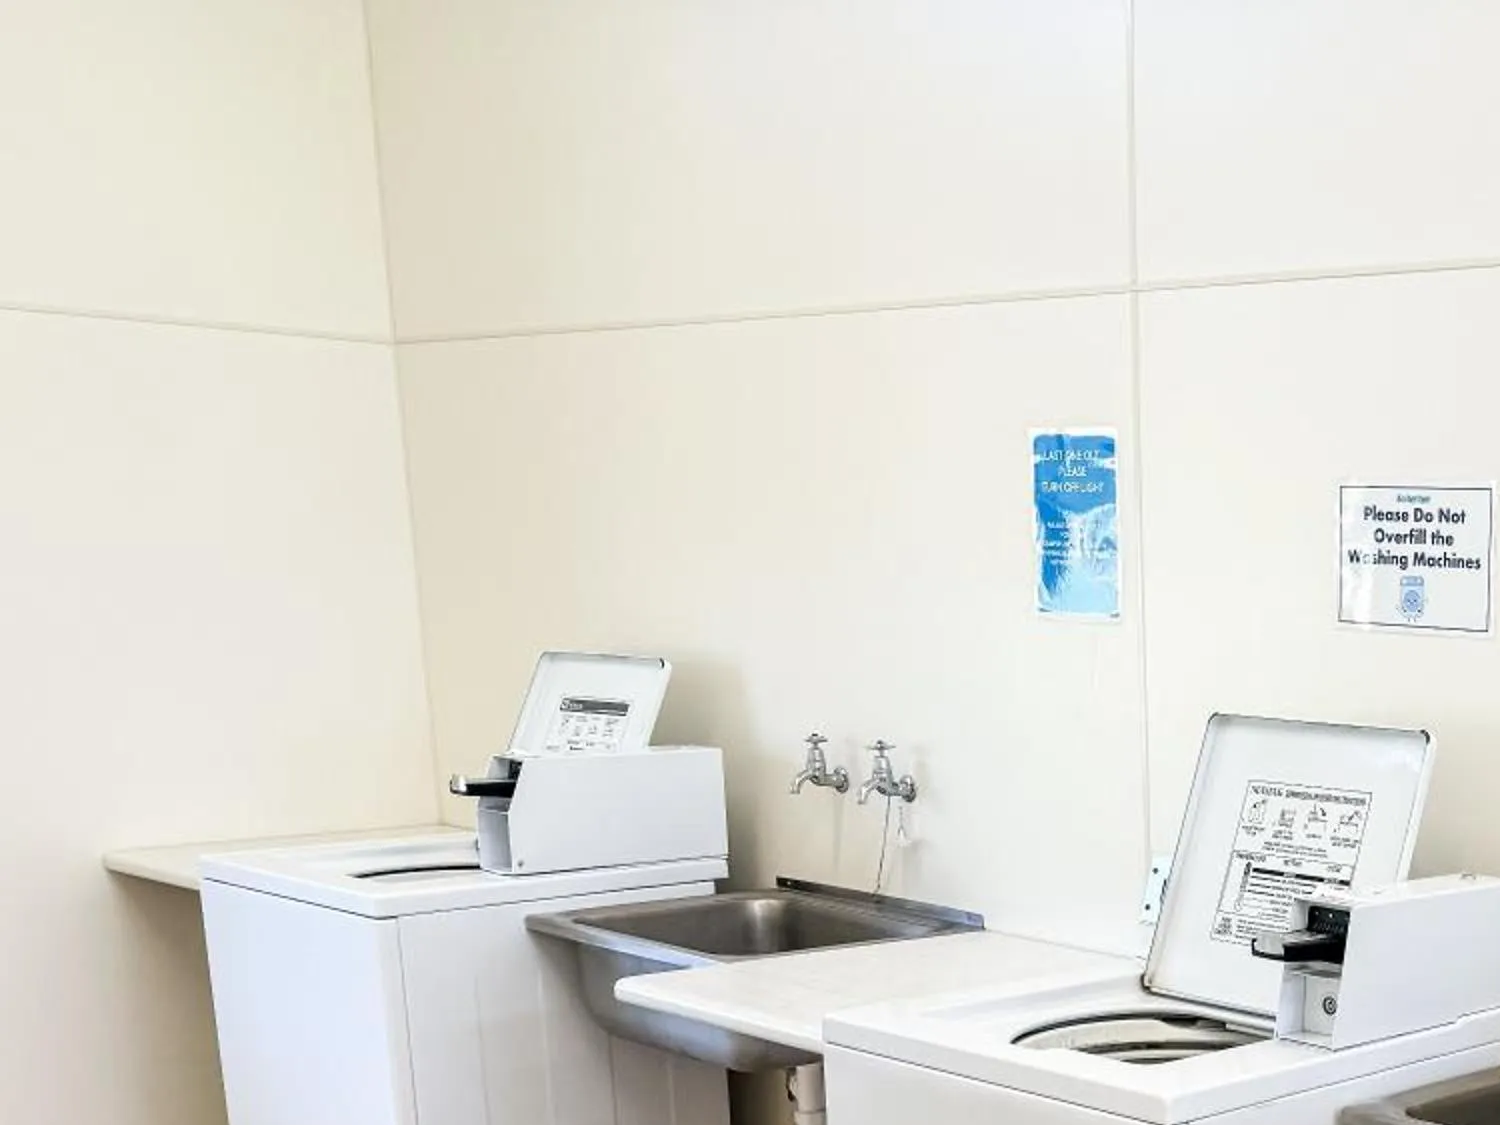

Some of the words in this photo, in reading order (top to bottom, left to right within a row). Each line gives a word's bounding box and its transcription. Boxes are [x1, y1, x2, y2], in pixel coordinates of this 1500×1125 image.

[1363, 505, 1409, 522] Please
[1413, 507, 1434, 523] Do
[1438, 508, 1466, 524] Not
[1374, 527, 1427, 545] Overfill
[1431, 530, 1454, 546] the
[1413, 551, 1481, 570] Machines
